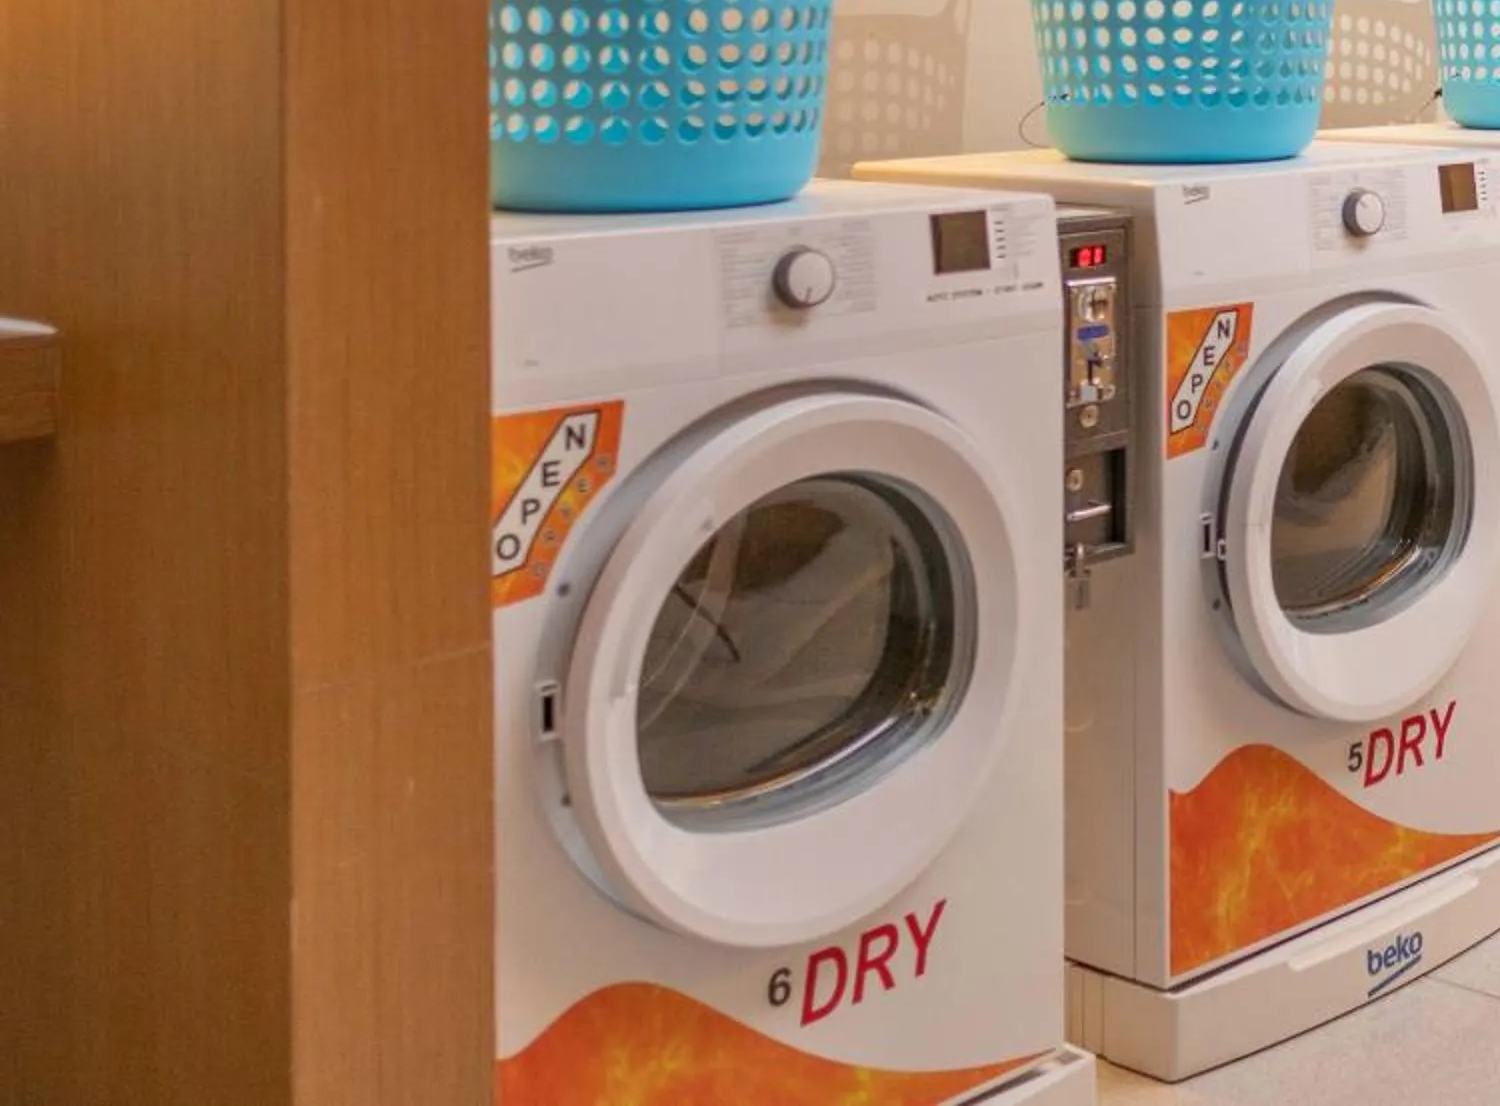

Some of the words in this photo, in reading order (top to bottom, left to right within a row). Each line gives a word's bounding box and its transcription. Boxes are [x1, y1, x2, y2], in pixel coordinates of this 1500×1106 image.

[1176, 317, 1231, 420] OPEN
[496, 423, 586, 561] OPEN
[1347, 740, 1363, 773] 5
[1363, 700, 1457, 789] DRY
[767, 966, 793, 1008] 6
[800, 898, 948, 1028] DRY
[1366, 930, 1423, 977] beko
